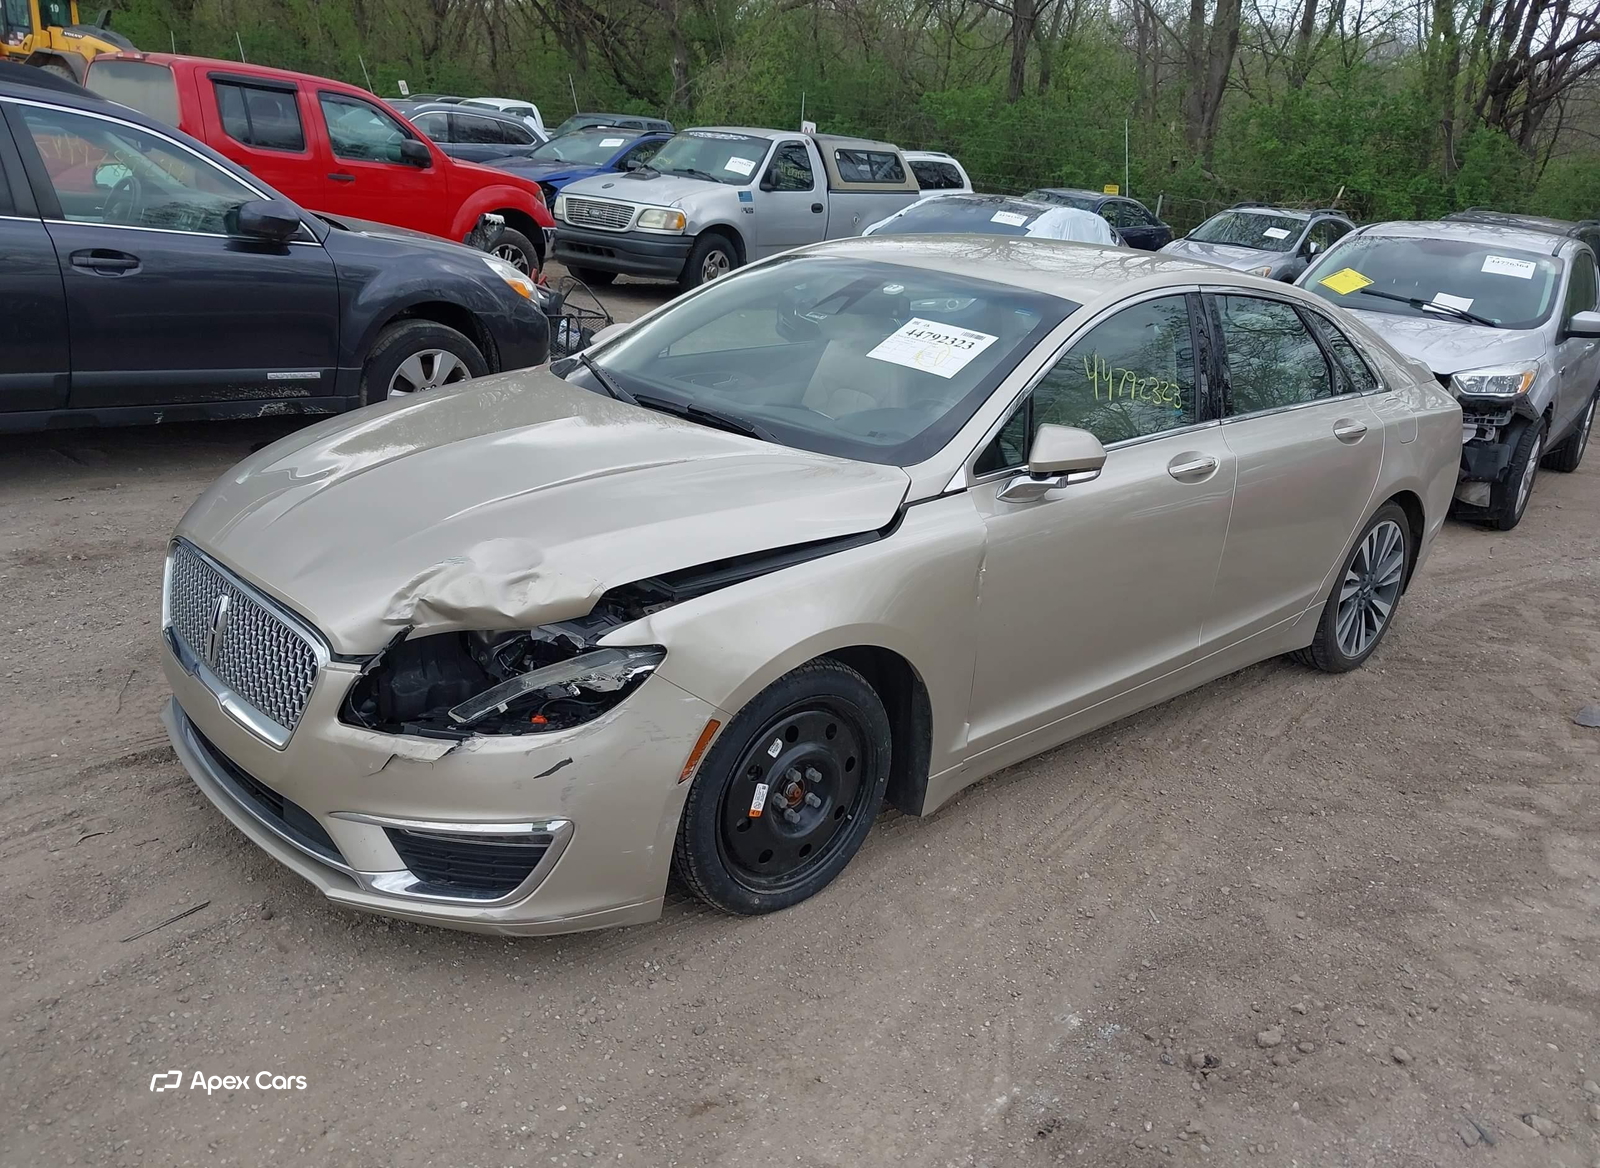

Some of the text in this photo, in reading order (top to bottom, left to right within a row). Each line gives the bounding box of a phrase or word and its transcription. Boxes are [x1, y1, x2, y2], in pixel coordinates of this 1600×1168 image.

[50, 4, 59, 13] 19
[906, 328, 975, 350] 44792323
[1084, 354, 1182, 409] 44792323
